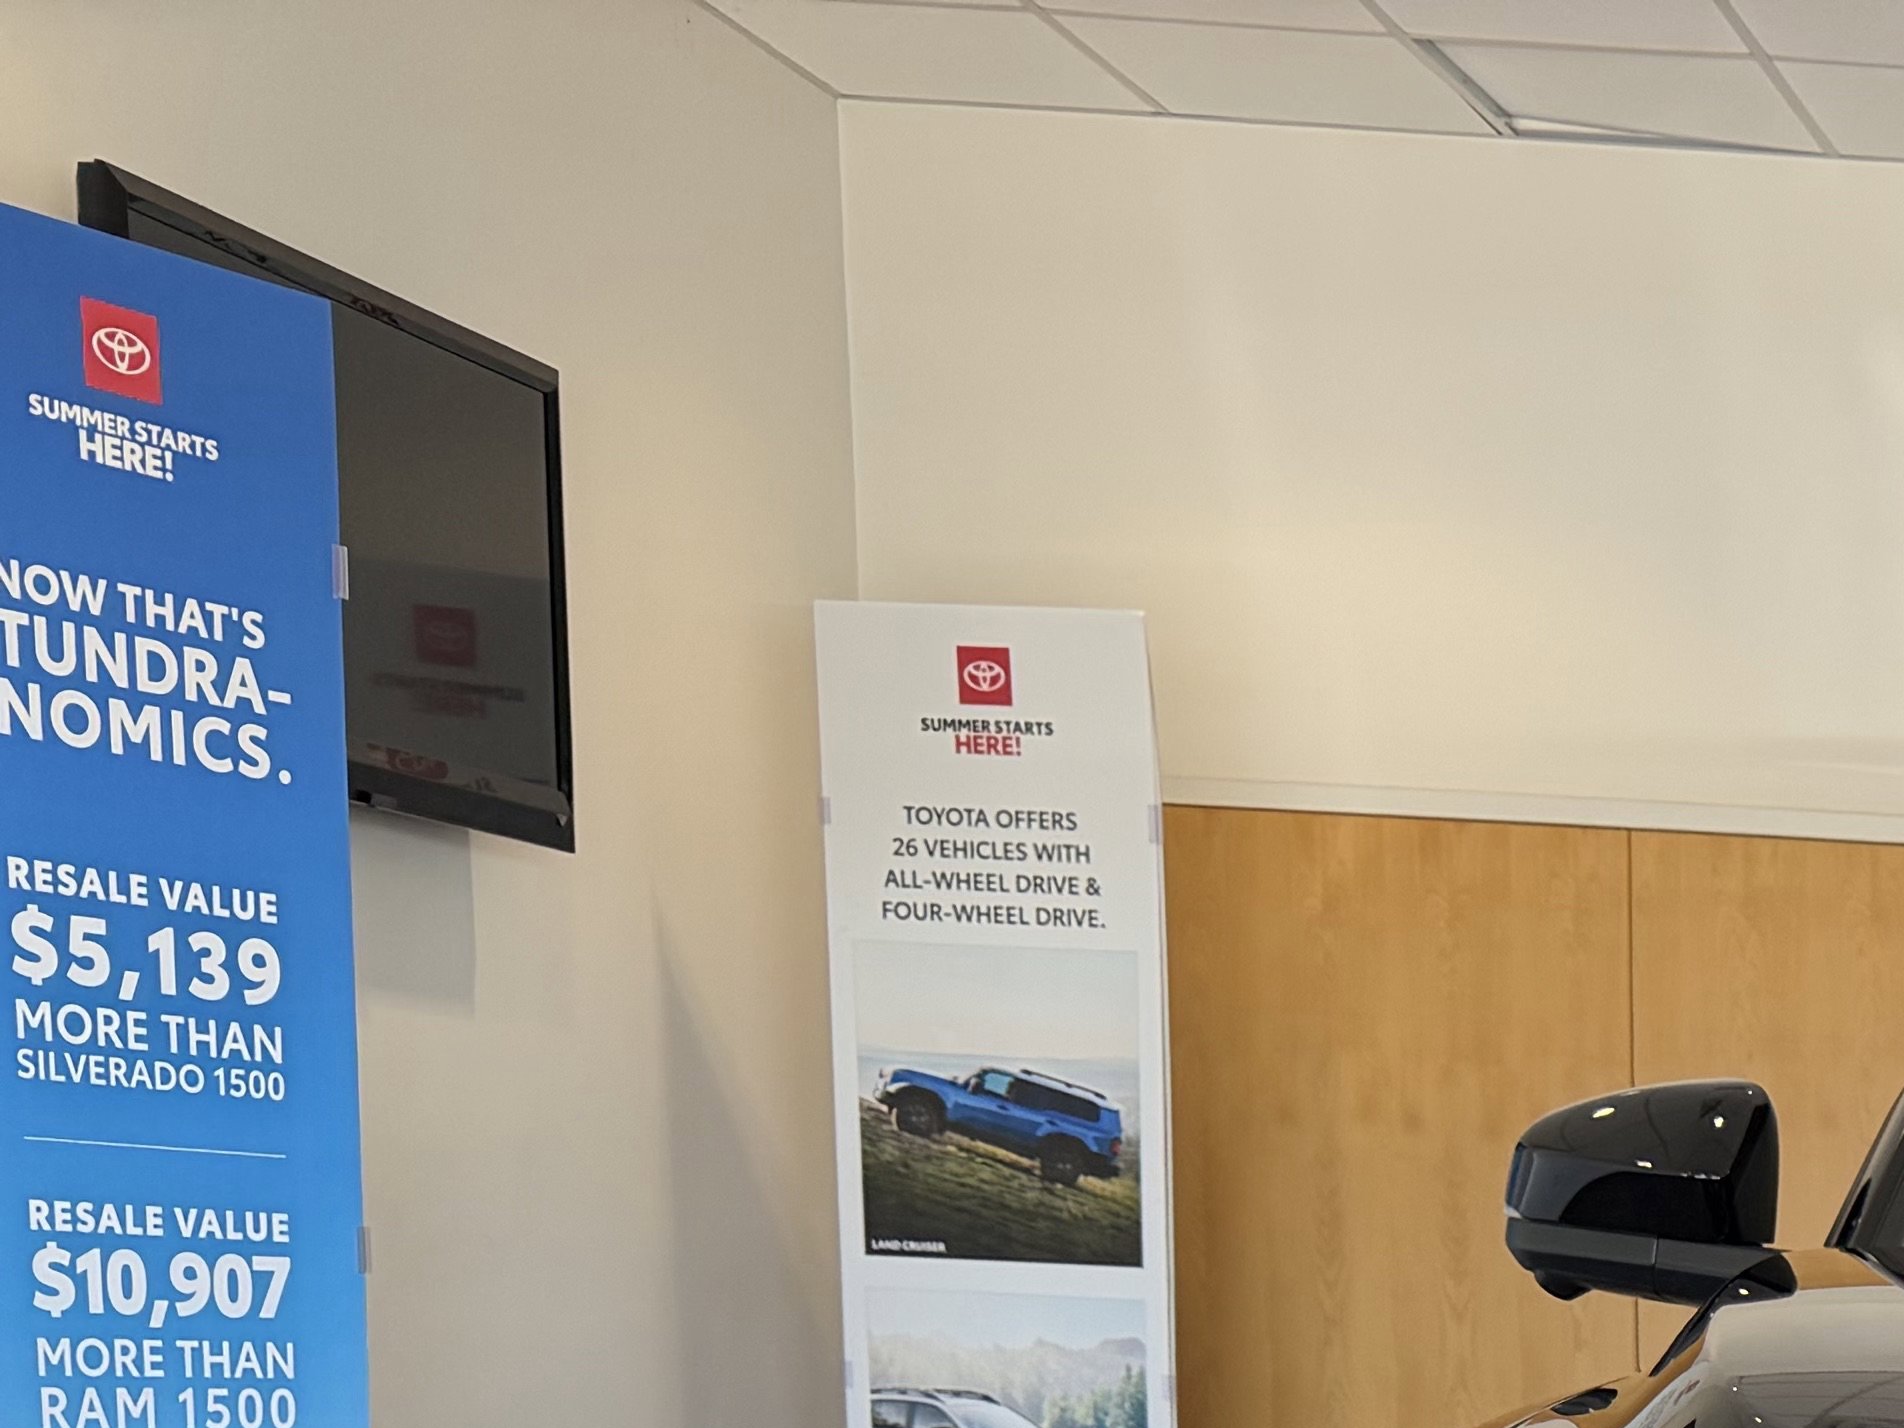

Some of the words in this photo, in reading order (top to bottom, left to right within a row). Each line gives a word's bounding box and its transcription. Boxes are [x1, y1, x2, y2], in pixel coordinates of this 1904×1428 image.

[28, 393, 131, 440] SUMMER
[135, 420, 219, 461] STARTS
[79, 428, 174, 482] HERE!
[0, 558, 107, 616] NOW
[117, 582, 266, 649] THAT'S
[0, 608, 292, 715] TUNDRA-
[0, 677, 292, 785] NOMICS.
[920, 716, 991, 734] SUMMER
[994, 719, 1055, 737] STARTS
[954, 734, 1022, 757] HERE!
[903, 805, 990, 828] TOYOTA
[995, 808, 1078, 832] OFFERS
[892, 837, 919, 857] 26
[923, 839, 1028, 862] VEHICLES
[1032, 842, 1091, 864] WITH
[6, 855, 149, 908] RESALE
[158, 877, 278, 925] VALUE
[884, 869, 1010, 894] ALL-WHEEL
[1015, 873, 1080, 896] DRIVE
[1084, 877, 1103, 897] &
[882, 901, 1030, 926] FOUR-WHEEL
[1035, 906, 1106, 930] DRIVE.
[11, 904, 281, 1006] $5,139
[15, 999, 149, 1053] MORE
[161, 1013, 283, 1064] THAN
[16, 1049, 205, 1094] SILVERADO
[214, 1067, 285, 1101] 1500
[28, 1198, 164, 1237] RESALE
[174, 1208, 290, 1243] VALUE
[31, 1242, 291, 1329] $10,907
[36, 1337, 165, 1378] MORE
[176, 1340, 295, 1380] THAN
